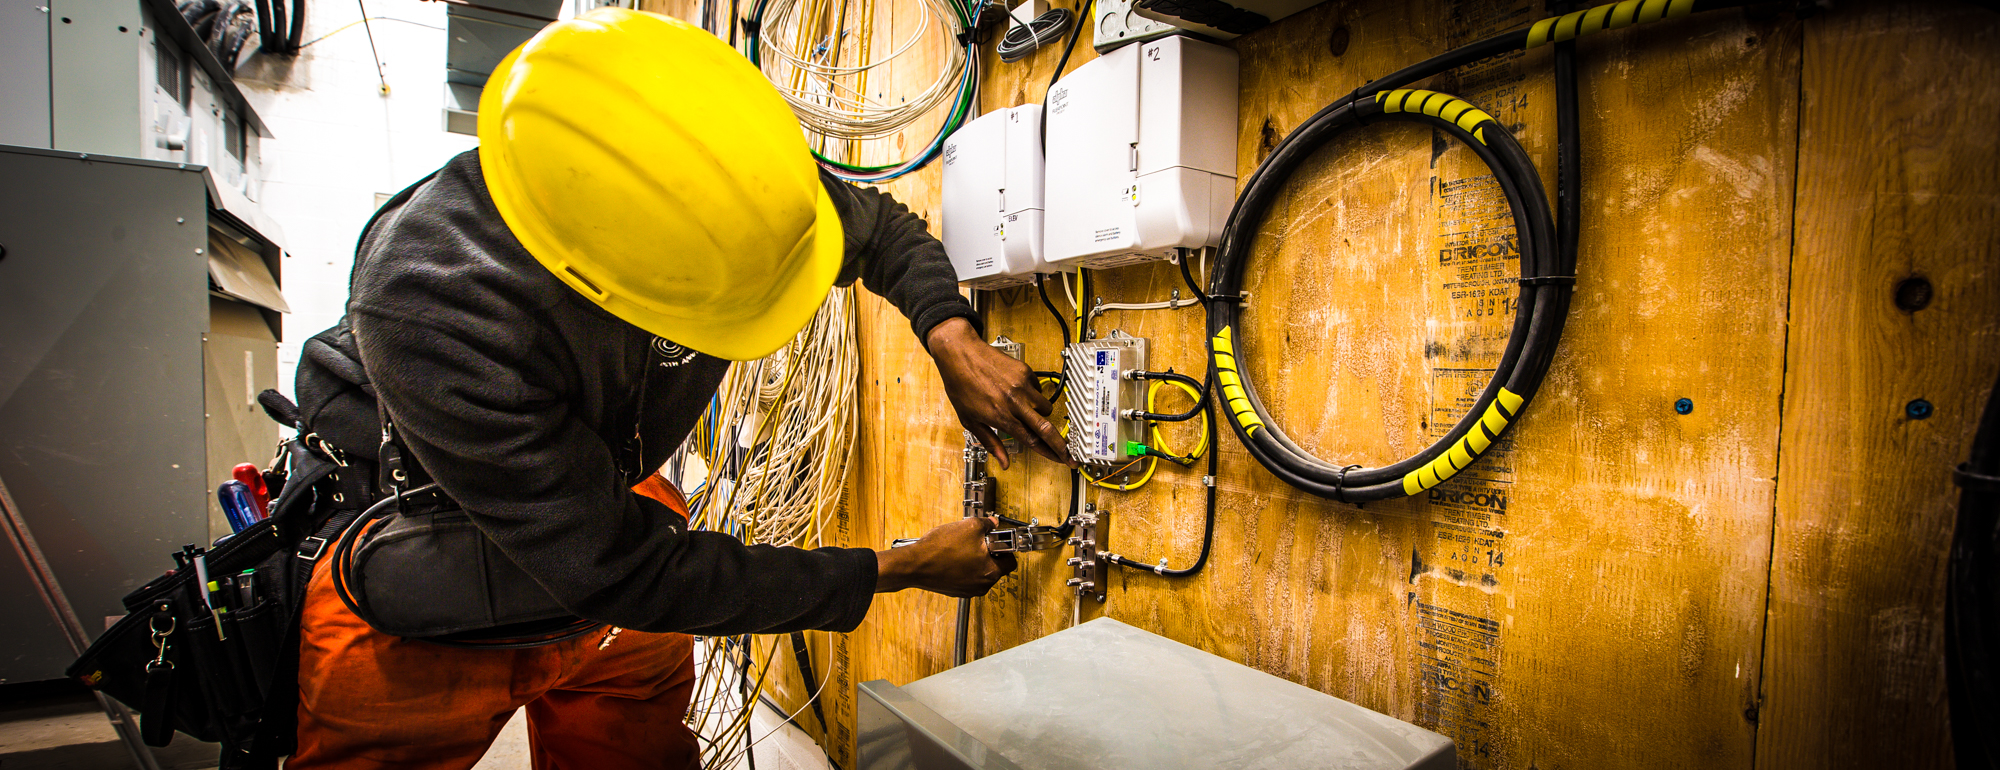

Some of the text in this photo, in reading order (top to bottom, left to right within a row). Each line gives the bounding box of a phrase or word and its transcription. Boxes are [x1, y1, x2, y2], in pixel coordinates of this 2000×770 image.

[1147, 47, 1161, 62] #2
[1509, 93, 1529, 114] 14
[1010, 110, 1019, 124] #1
[1440, 240, 1520, 262] DRICON
[1489, 287, 1509, 296] KDAT
[1428, 487, 1507, 510] DRICON
[1444, 508, 1491, 521] TRENT TIMBER
[1444, 515, 1490, 528] TREATING LTD.
[1474, 537, 1494, 548] KDAT
[1451, 552, 1478, 564] A O D
[1486, 550, 1504, 567] 14
[1426, 629, 1450, 640] PROCESS
[1438, 622, 1456, 634] WOOD
[1436, 639, 1467, 653] MONITORED
[1436, 646, 1464, 659] PRODUCTS
[1472, 739, 1490, 758] 14
